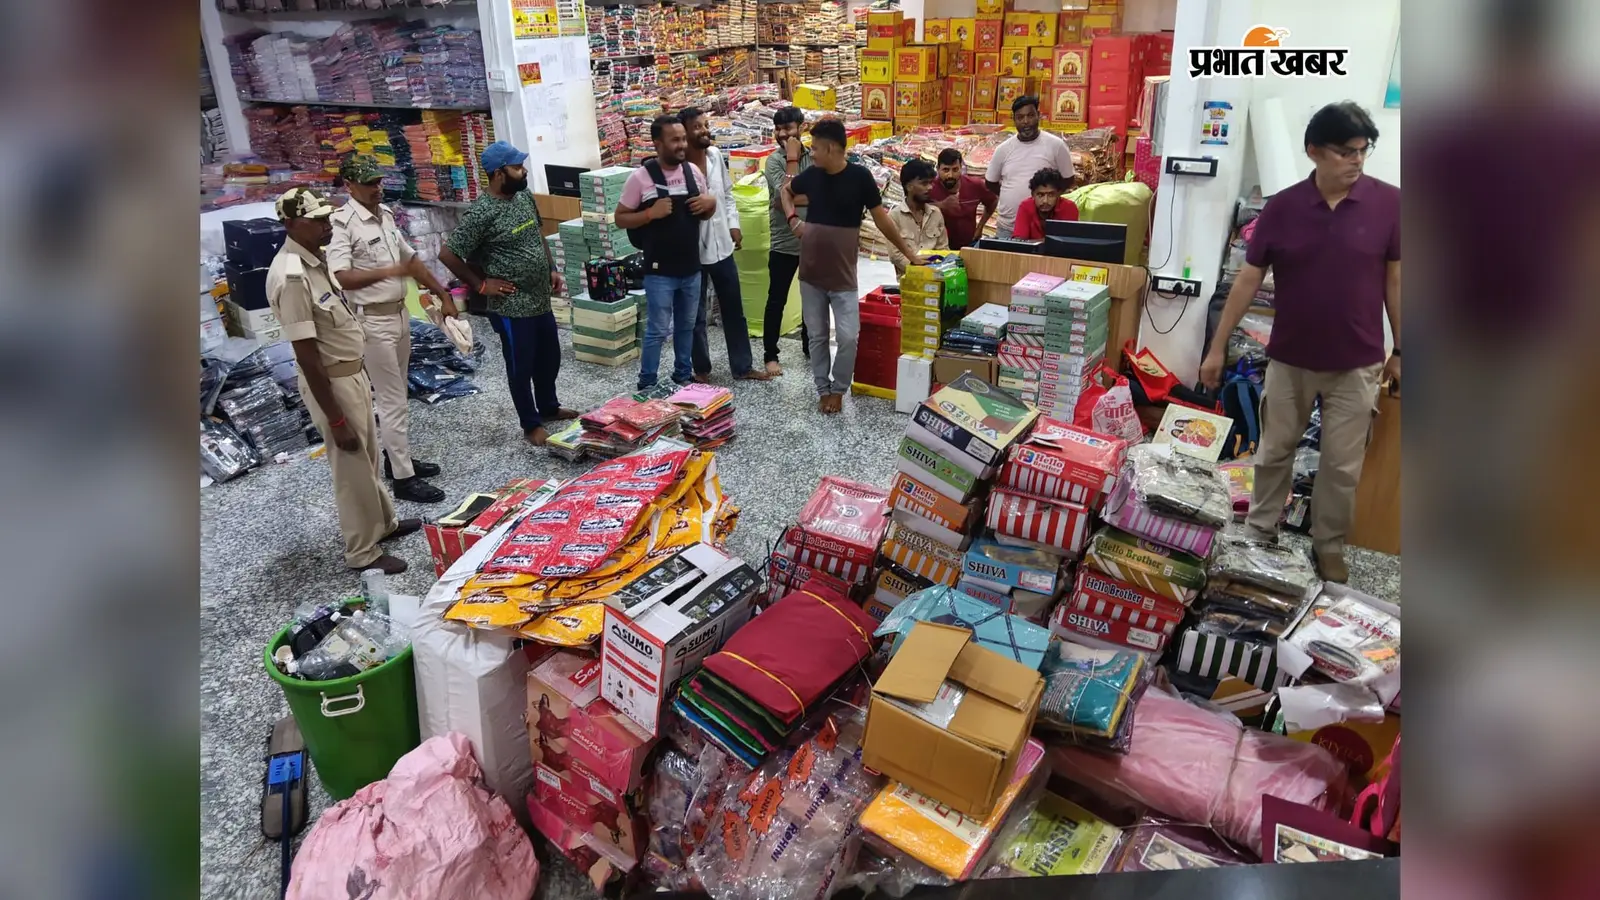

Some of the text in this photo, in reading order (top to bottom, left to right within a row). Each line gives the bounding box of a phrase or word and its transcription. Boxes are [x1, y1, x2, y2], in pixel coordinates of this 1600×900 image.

[919, 410, 956, 441] SHIVA
[939, 401, 999, 440] SHIVA
[905, 445, 937, 470] SHIVA
[1036, 453, 1063, 470] Hello
[914, 486, 937, 502] Hello
[812, 517, 870, 541] AWESOME
[899, 530, 932, 552] SHIVA
[815, 536, 845, 554] Brother
[1100, 539, 1162, 569] Hello Brother
[968, 561, 1008, 579] SHIVA
[965, 586, 1003, 605] SHIVA
[1086, 575, 1141, 604] Hello Brother
[688, 623, 718, 649] SUMO
[1068, 613, 1110, 634] SHIVA
[622, 628, 653, 656] SUMO
[572, 728, 606, 755] Sanjay
[771, 822, 799, 863] ROHINI
